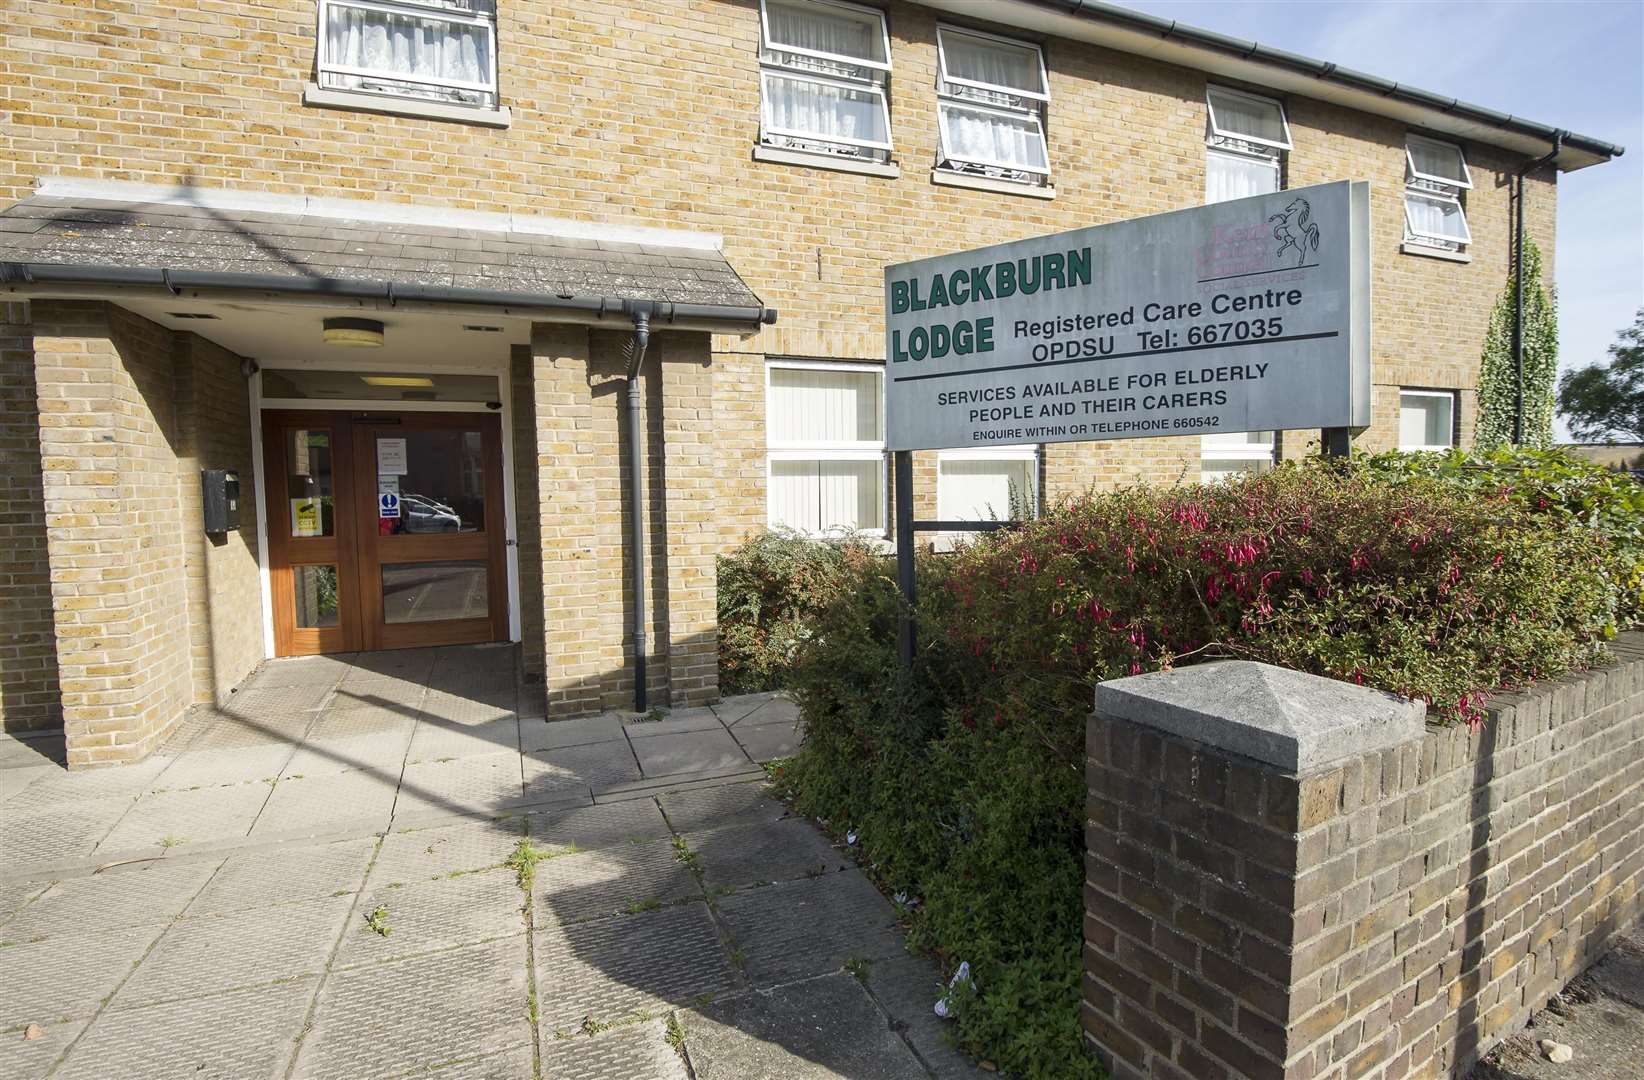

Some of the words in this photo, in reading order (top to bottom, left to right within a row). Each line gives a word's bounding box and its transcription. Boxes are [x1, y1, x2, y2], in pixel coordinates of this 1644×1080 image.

[891, 247, 1091, 314] BLACKBURN
[1014, 307, 1134, 339] Registered
[1143, 302, 1201, 323] Care
[1211, 288, 1302, 315] Centre
[893, 317, 994, 363] LODGE
[1032, 336, 1114, 361] OPDSU
[1137, 329, 1178, 350] Tel:
[1187, 317, 1283, 346] 667035
[938, 386, 1016, 406] SERVICES
[1022, 376, 1119, 398] AVAILABLE
[1127, 373, 1166, 389] FOR
[1175, 363, 1269, 384] ELDERLY
[970, 405, 1033, 422] PEOPLE
[1039, 401, 1075, 417] AND
[1082, 399, 1136, 414] THEIR
[1143, 390, 1227, 410] CARERS
[973, 428, 1022, 441] ENQUIRE
[1025, 425, 1066, 437] WITHIN
[1069, 424, 1087, 434] OR
[1091, 419, 1169, 433] TELEPHONE
[1173, 416, 1219, 429] 660542
